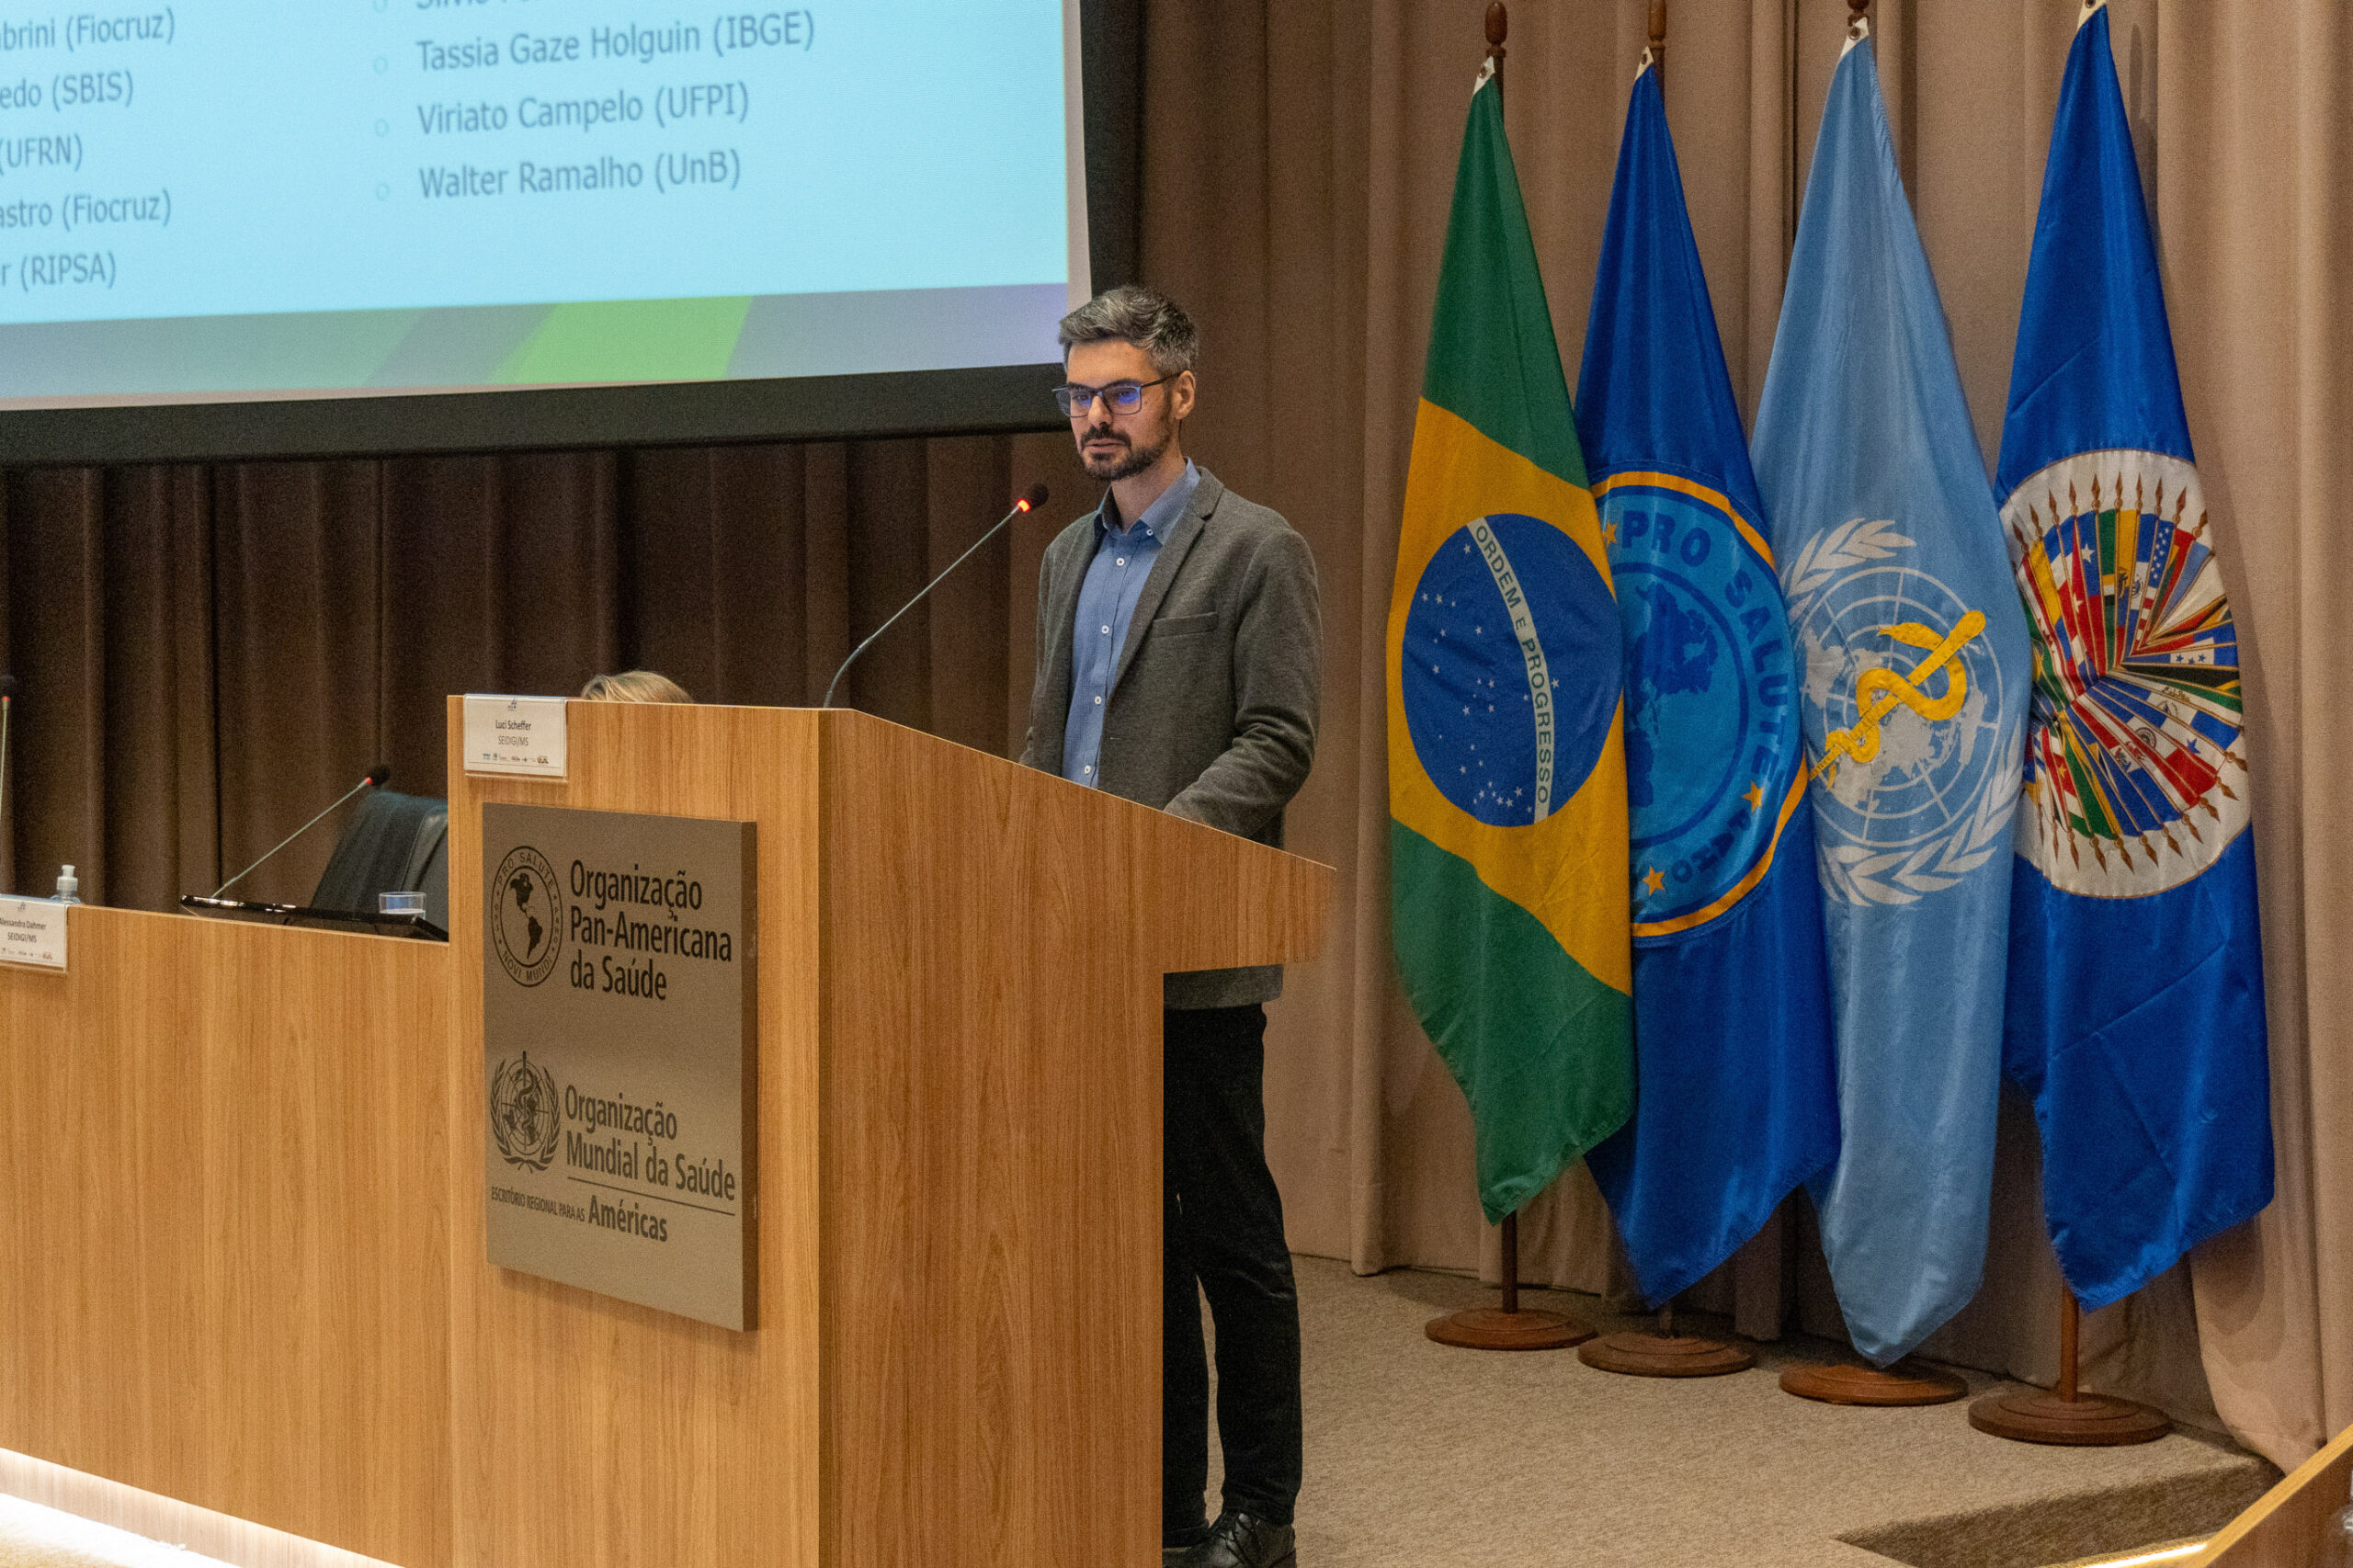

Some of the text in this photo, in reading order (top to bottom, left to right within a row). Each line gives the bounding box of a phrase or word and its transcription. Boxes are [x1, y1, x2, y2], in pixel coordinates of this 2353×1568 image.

[0, 7, 175, 52] brini (Fiocruz)
[416, 9, 814, 72] Tassia Gaze Holguin (IBGE)
[0, 70, 133, 112] edo (SBIS)
[417, 80, 749, 135] Viriato Campelo (UFPI)
[0, 133, 83, 176] (UFRN)
[419, 148, 740, 199] Walter Ramalho (UnB)
[63, 187, 171, 232] (Fiocruz)
[20, 251, 116, 292] (RIPSA)
[1476, 526, 1552, 804] ORDEM E PROGRESSO
[1621, 510, 1789, 781] PRO SALUTE
[495, 720, 506, 730] Luci
[497, 852, 556, 889] PRO SALUTE
[570, 859, 702, 919] Organização
[570, 905, 732, 962] Pan-Americana
[503, 950, 553, 983] NOVI MUNDI
[570, 949, 667, 1001] da Saúde
[564, 1085, 677, 1146] Organização
[566, 1130, 736, 1201] Mundial da Saúde
[491, 1186, 668, 1243] ESCRITÓRIO REGIONAL PARA AS Américas
